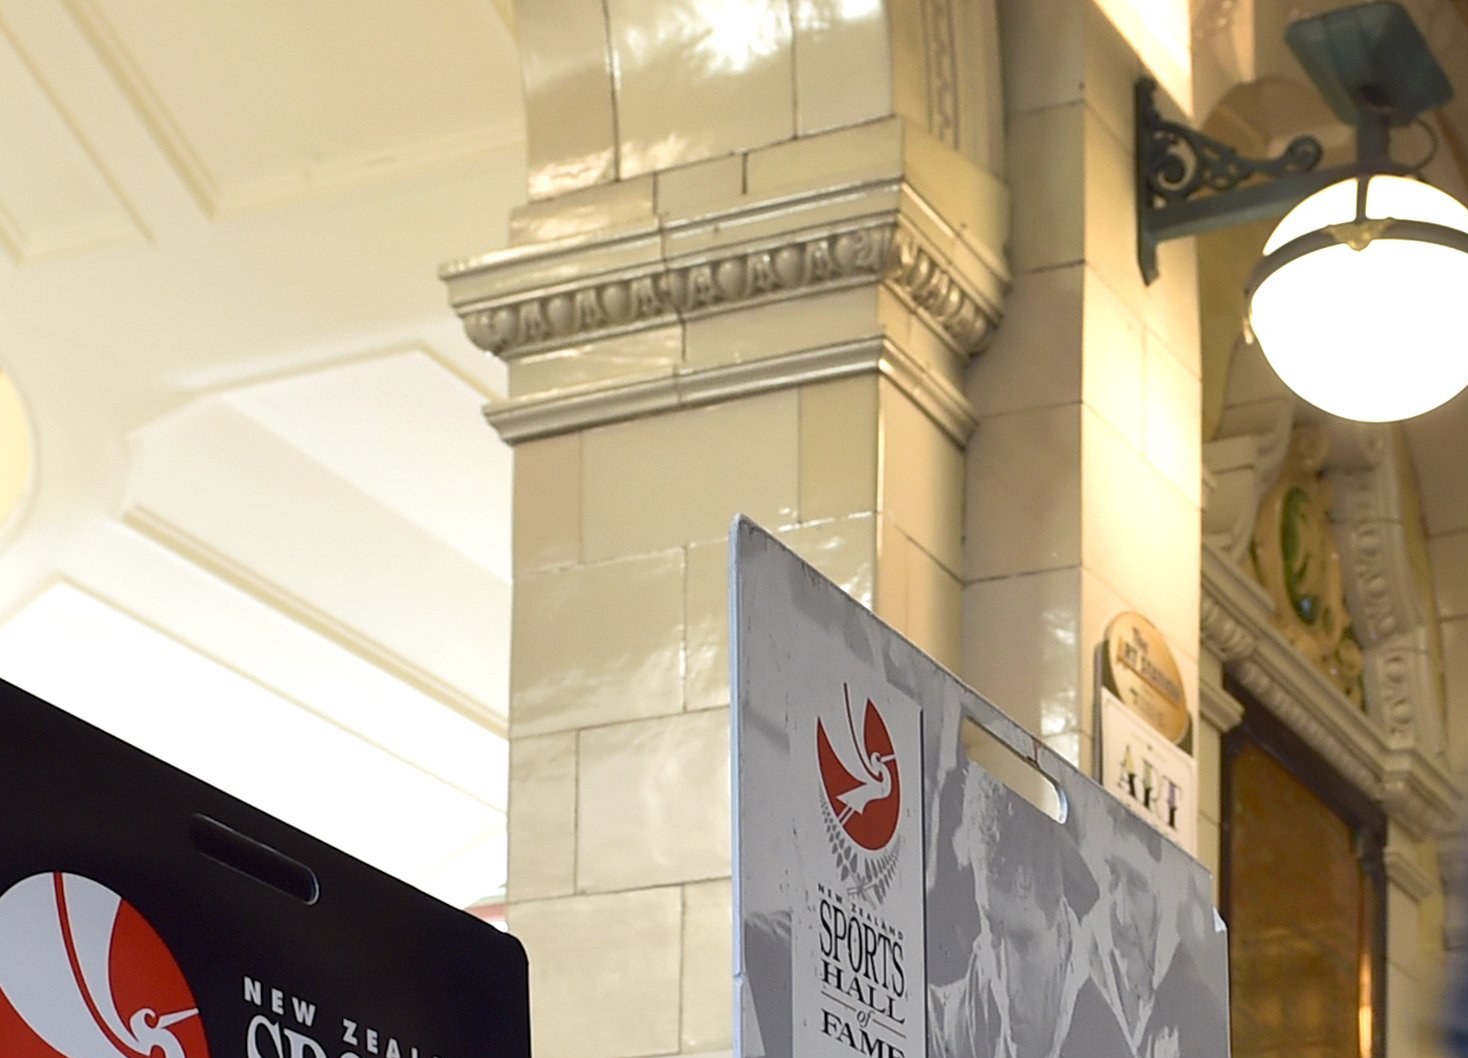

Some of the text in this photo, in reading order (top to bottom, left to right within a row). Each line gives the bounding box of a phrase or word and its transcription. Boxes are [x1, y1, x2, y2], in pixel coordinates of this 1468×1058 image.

[818, 883, 904, 940] NEW ZEALAND
[819, 899, 905, 997] SPORTS
[244, 976, 316, 1027] NEW
[821, 958, 906, 1025] HALL
[856, 1009, 876, 1028] of
